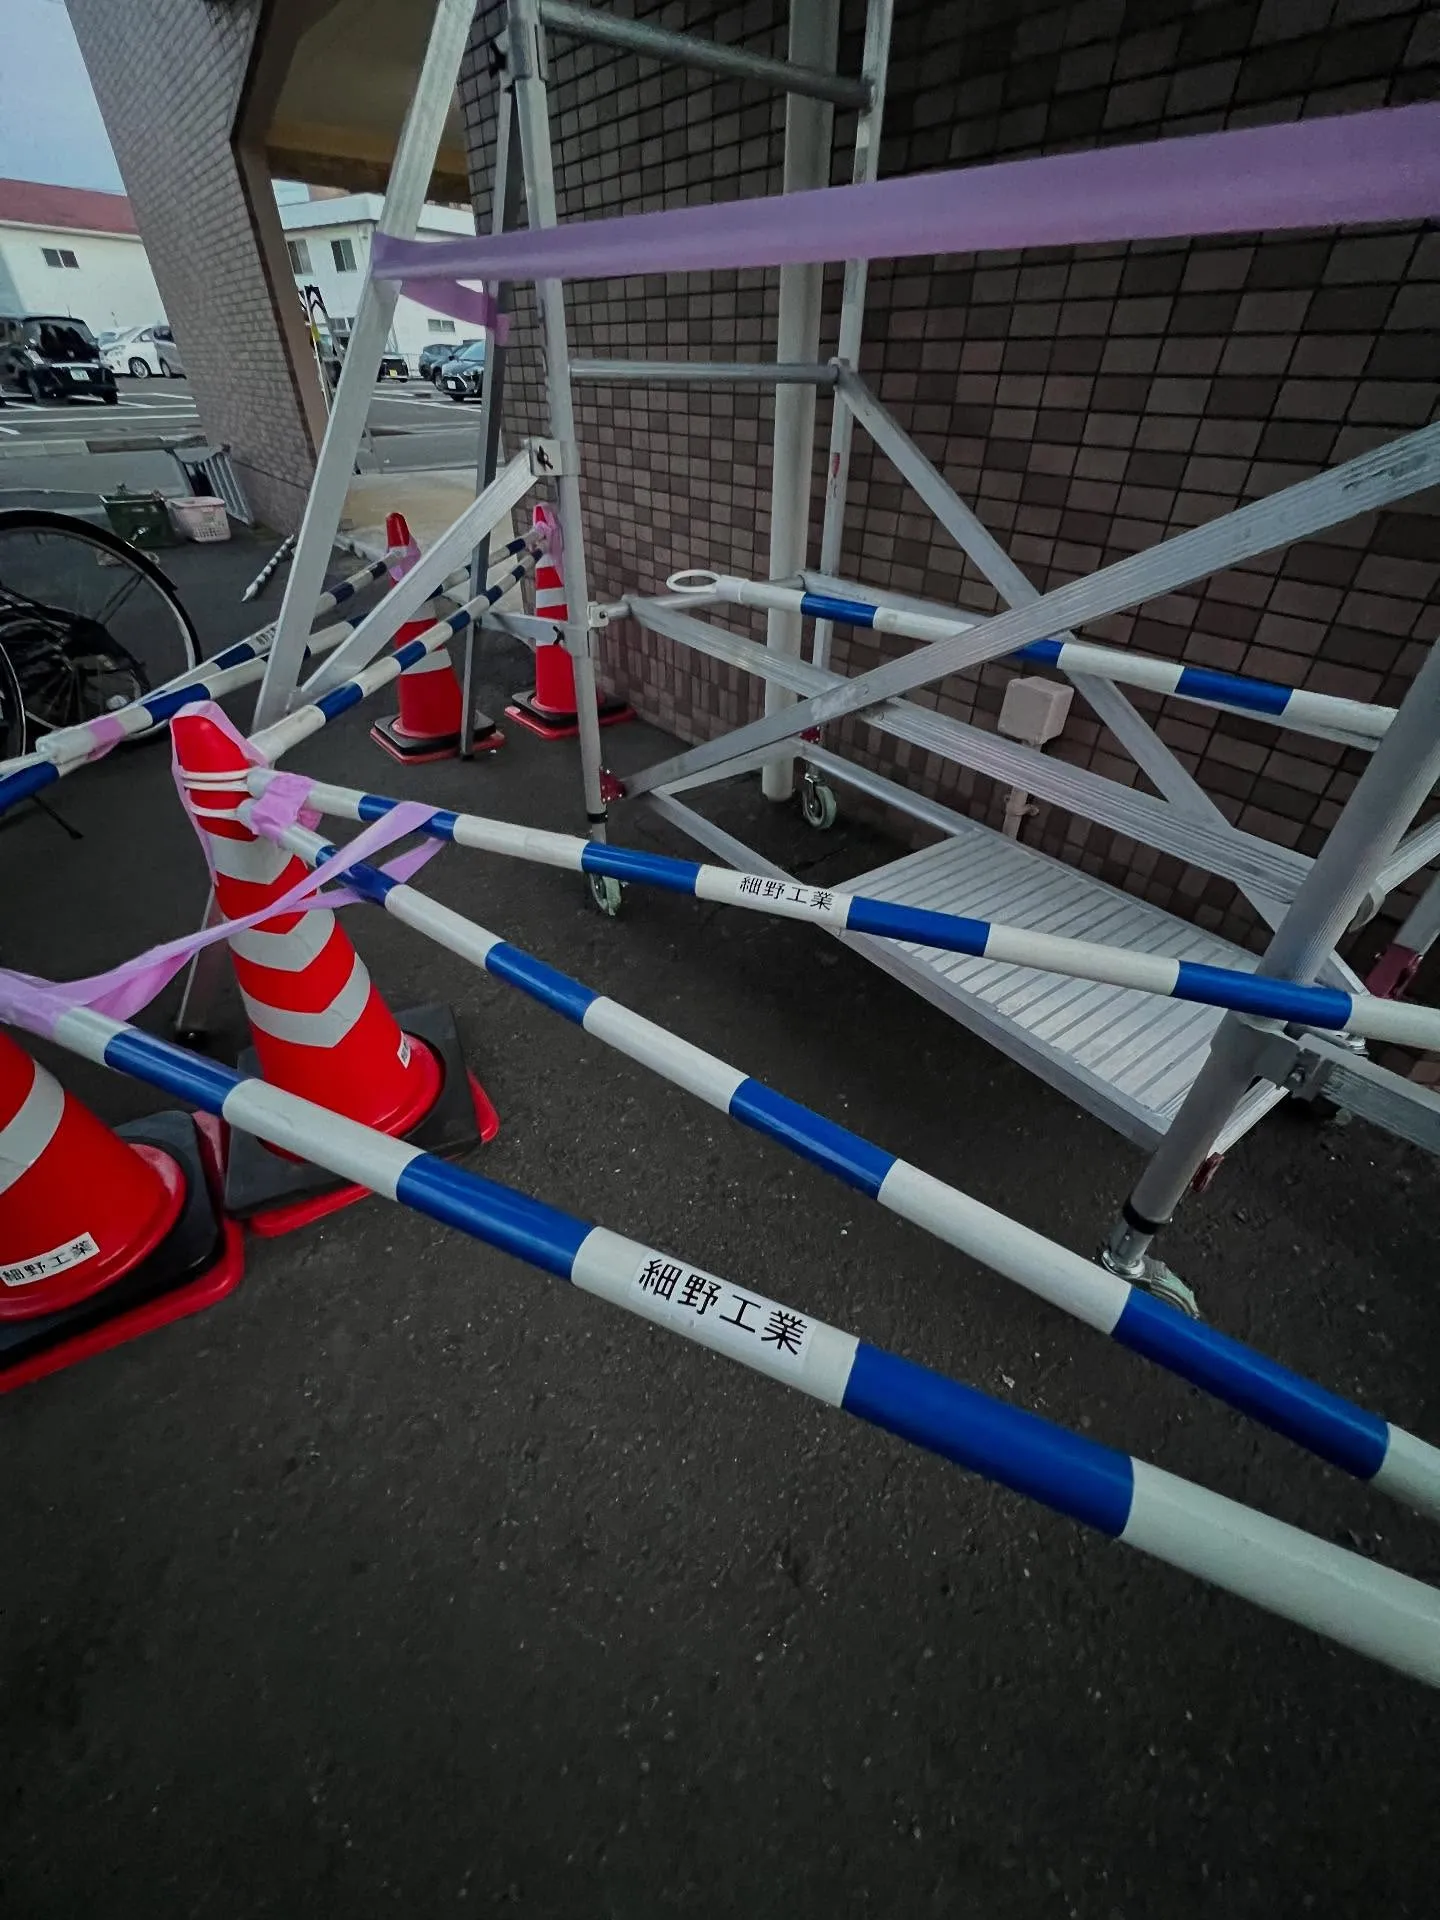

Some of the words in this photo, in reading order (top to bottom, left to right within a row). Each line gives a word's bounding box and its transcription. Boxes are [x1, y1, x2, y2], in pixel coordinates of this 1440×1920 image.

[739, 877, 834, 911] 細野工業
[638, 1259, 808, 1355] 細野工業
